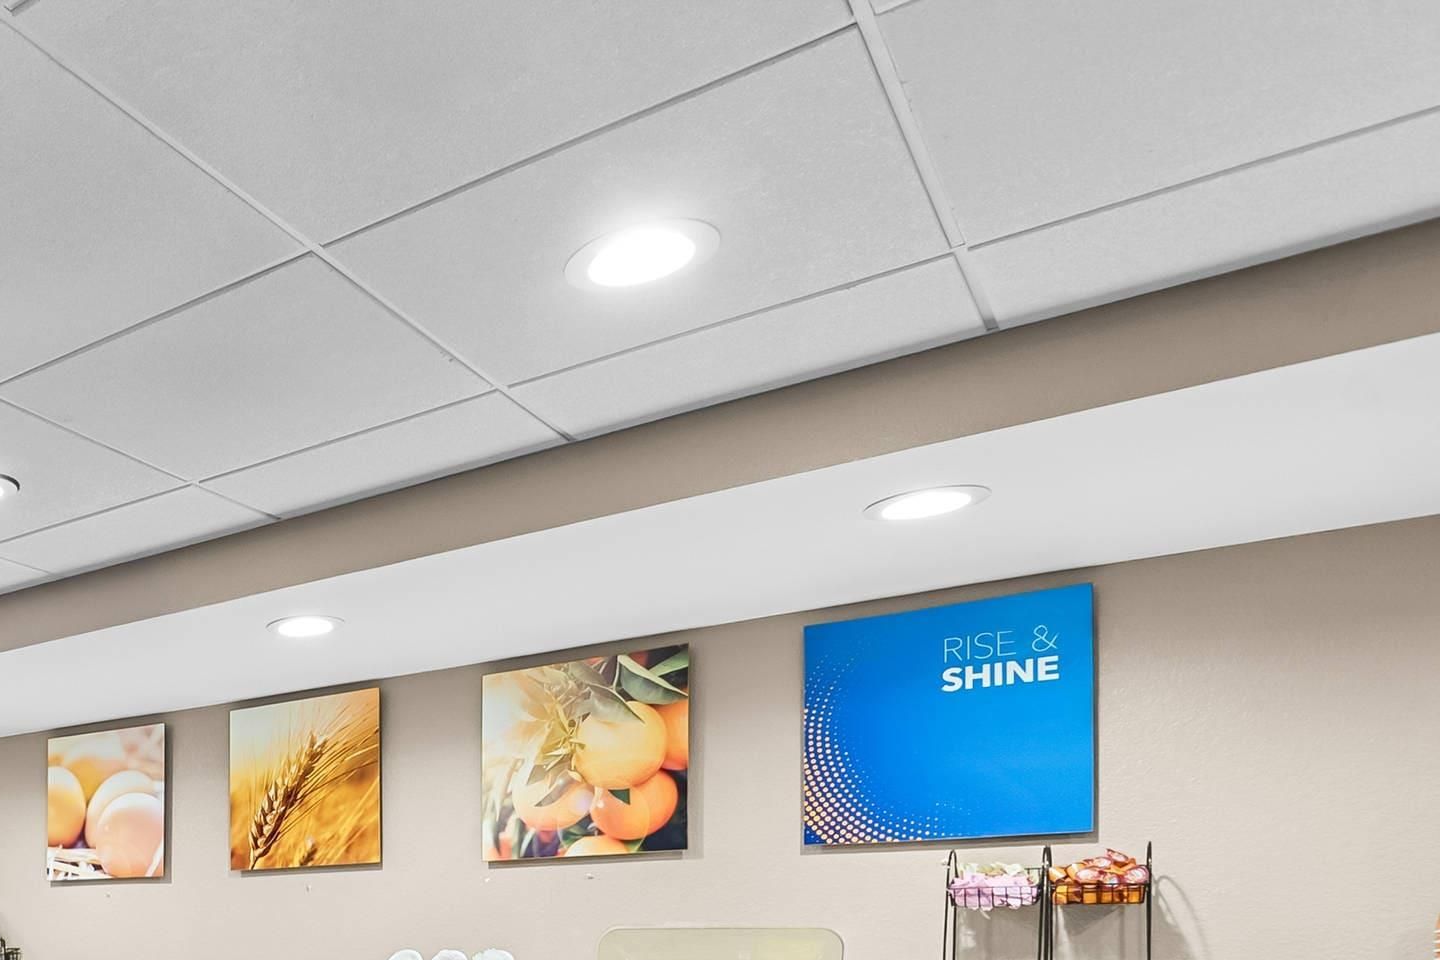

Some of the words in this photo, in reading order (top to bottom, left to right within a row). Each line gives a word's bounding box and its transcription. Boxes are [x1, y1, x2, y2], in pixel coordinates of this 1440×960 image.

[944, 630, 1017, 663] RISE
[1031, 624, 1059, 652] &
[941, 655, 1060, 692] SHINE
